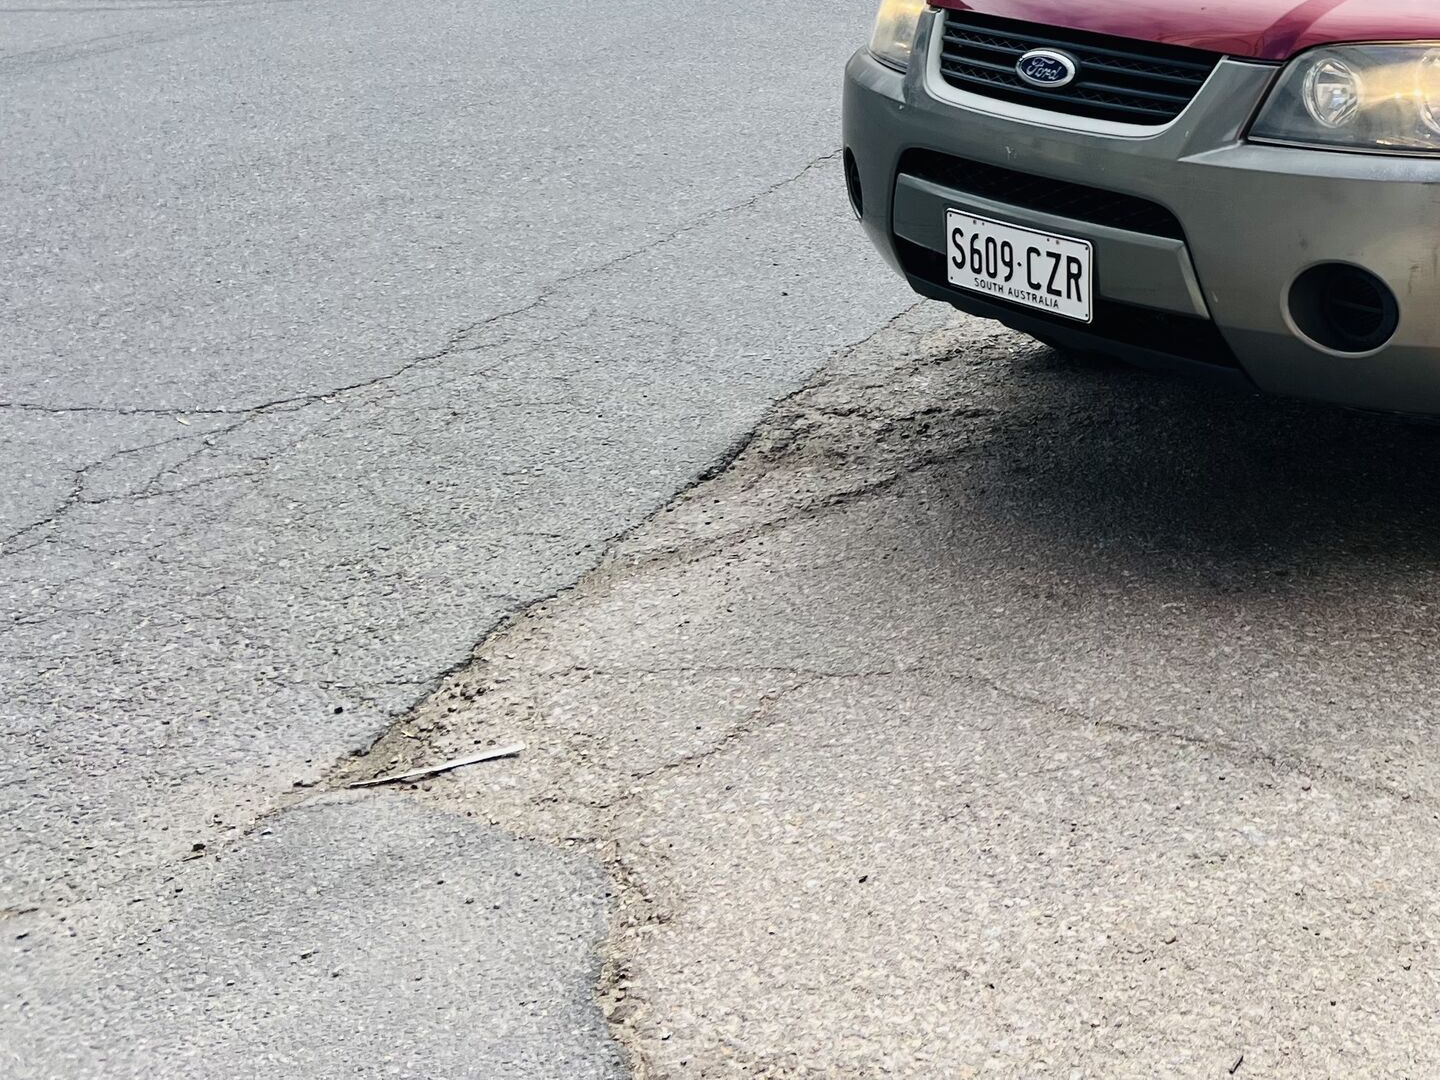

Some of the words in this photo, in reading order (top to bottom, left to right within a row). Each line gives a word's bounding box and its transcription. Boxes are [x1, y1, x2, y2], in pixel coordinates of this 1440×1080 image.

[1026, 57, 1063, 80] Ford
[974, 277, 1004, 294] SOUTH
[1008, 287, 1060, 309] AUSTRALIA
